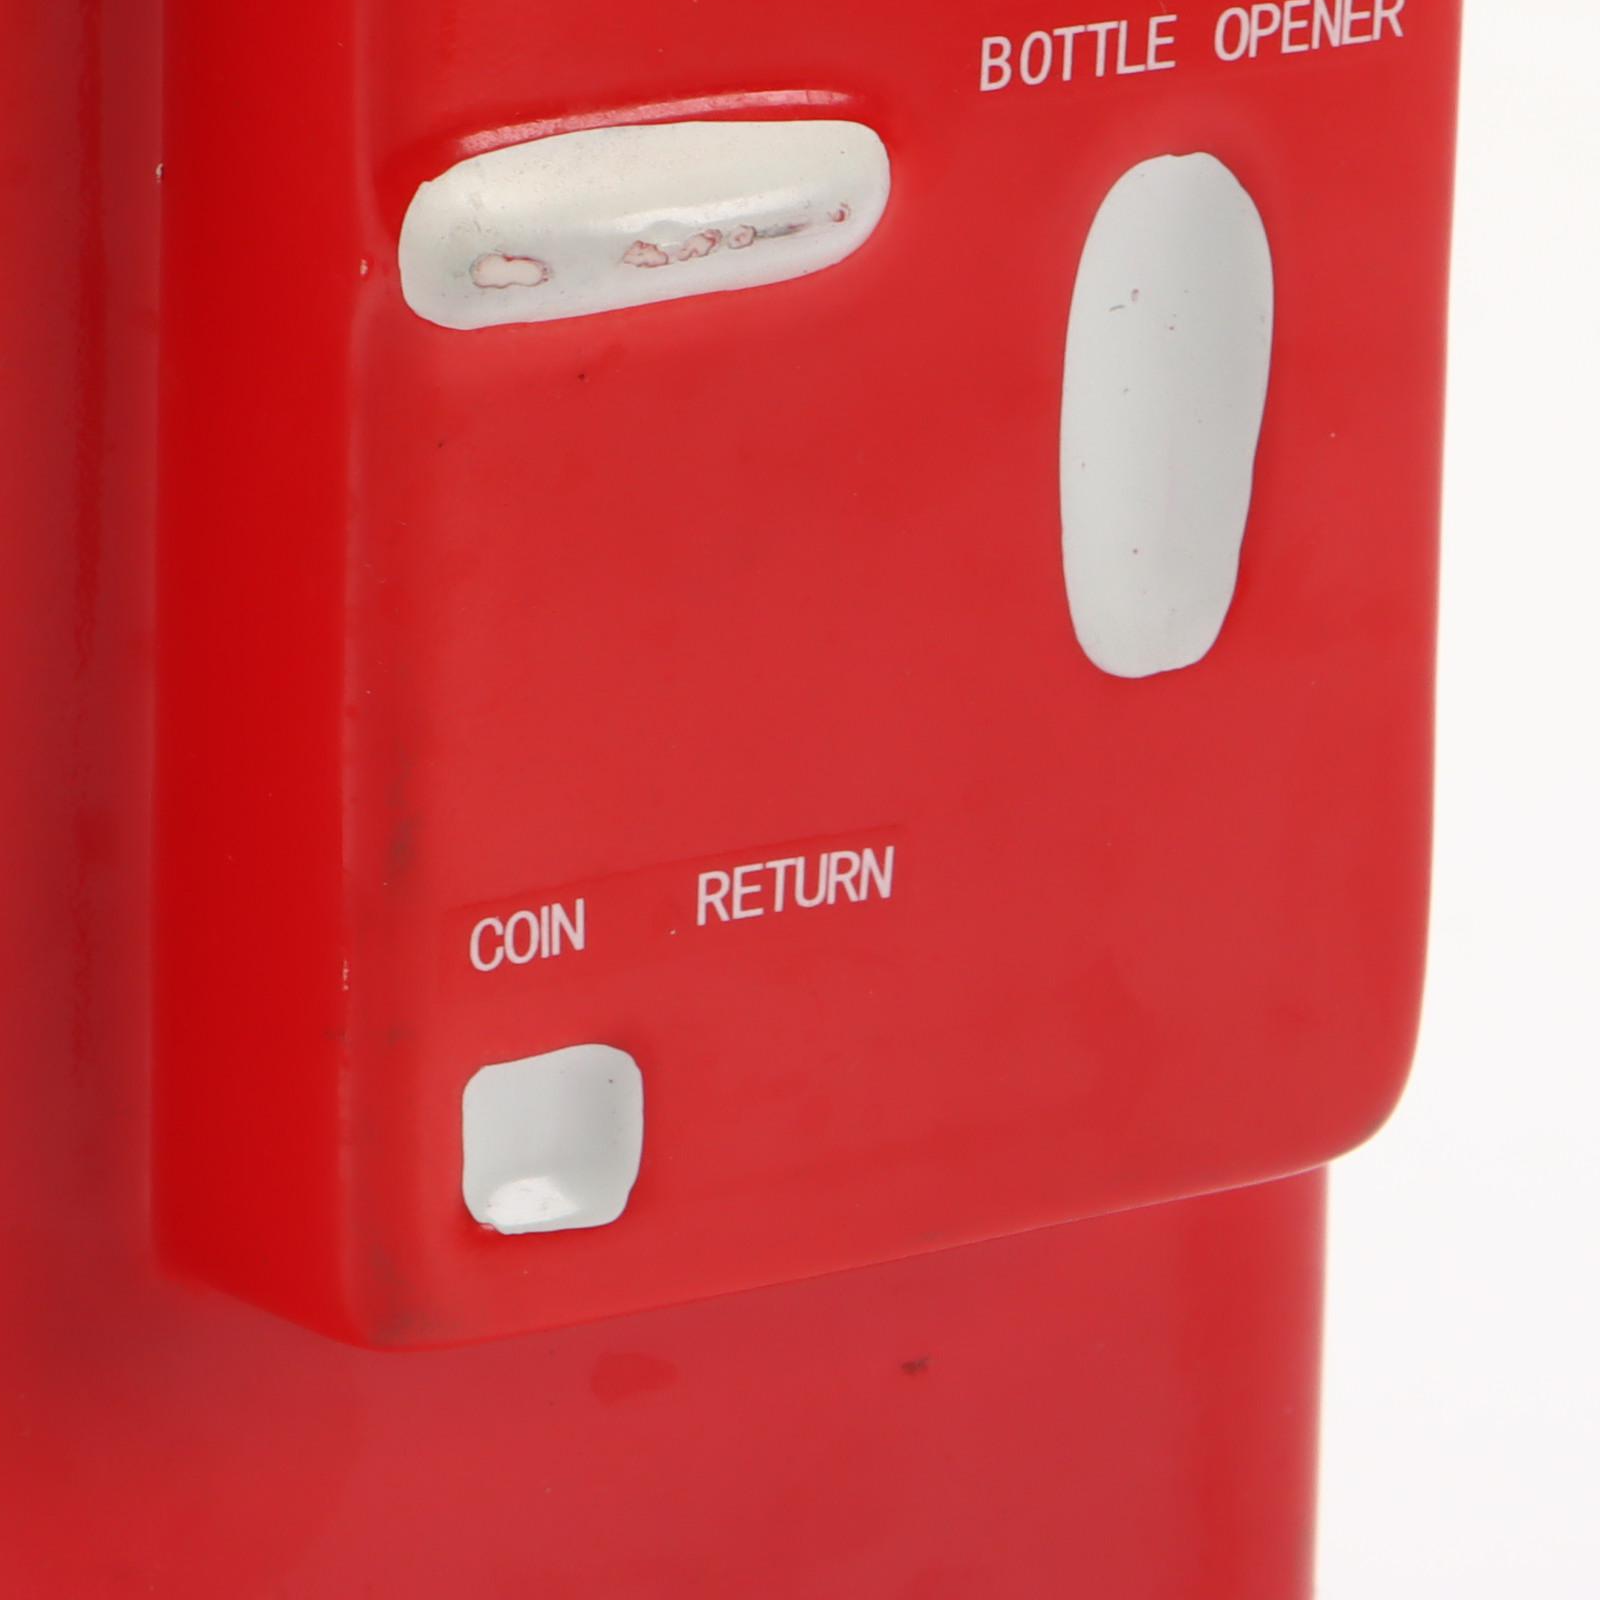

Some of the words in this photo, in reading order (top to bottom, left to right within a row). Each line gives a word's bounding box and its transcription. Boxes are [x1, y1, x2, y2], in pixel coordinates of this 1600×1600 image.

[980, 14, 1177, 91] BOTTLE
[470, 898, 585, 972] COIN
[697, 845, 895, 926] RETURN
